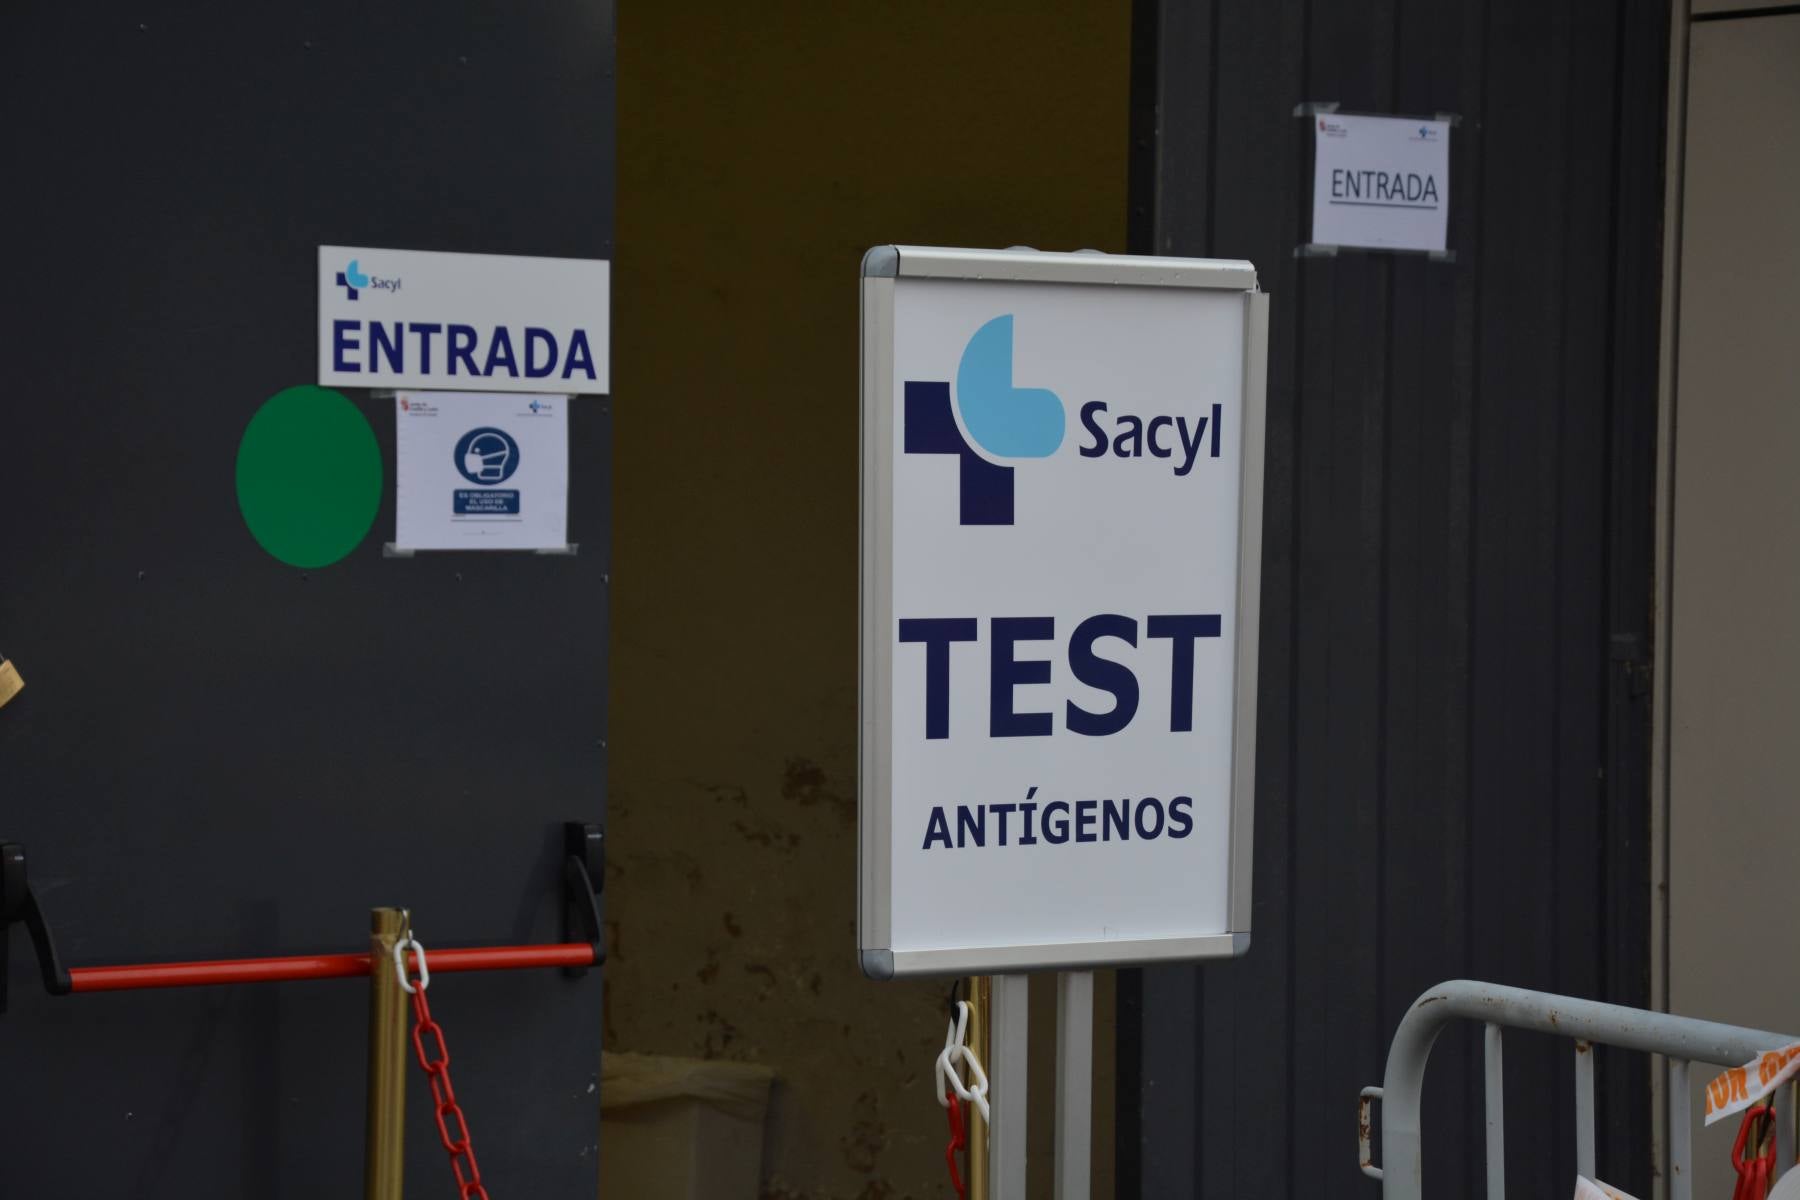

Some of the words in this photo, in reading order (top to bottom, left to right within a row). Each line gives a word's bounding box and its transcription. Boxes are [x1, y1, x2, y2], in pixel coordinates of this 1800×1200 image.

[1331, 168, 1439, 203] ENTRADA
[370, 276, 402, 293] Sacyl
[333, 319, 597, 380] ENTRADA
[1078, 400, 1222, 477] Sacyl
[898, 613, 1222, 741] TEST
[922, 786, 1195, 851] ANTÍGENOS
